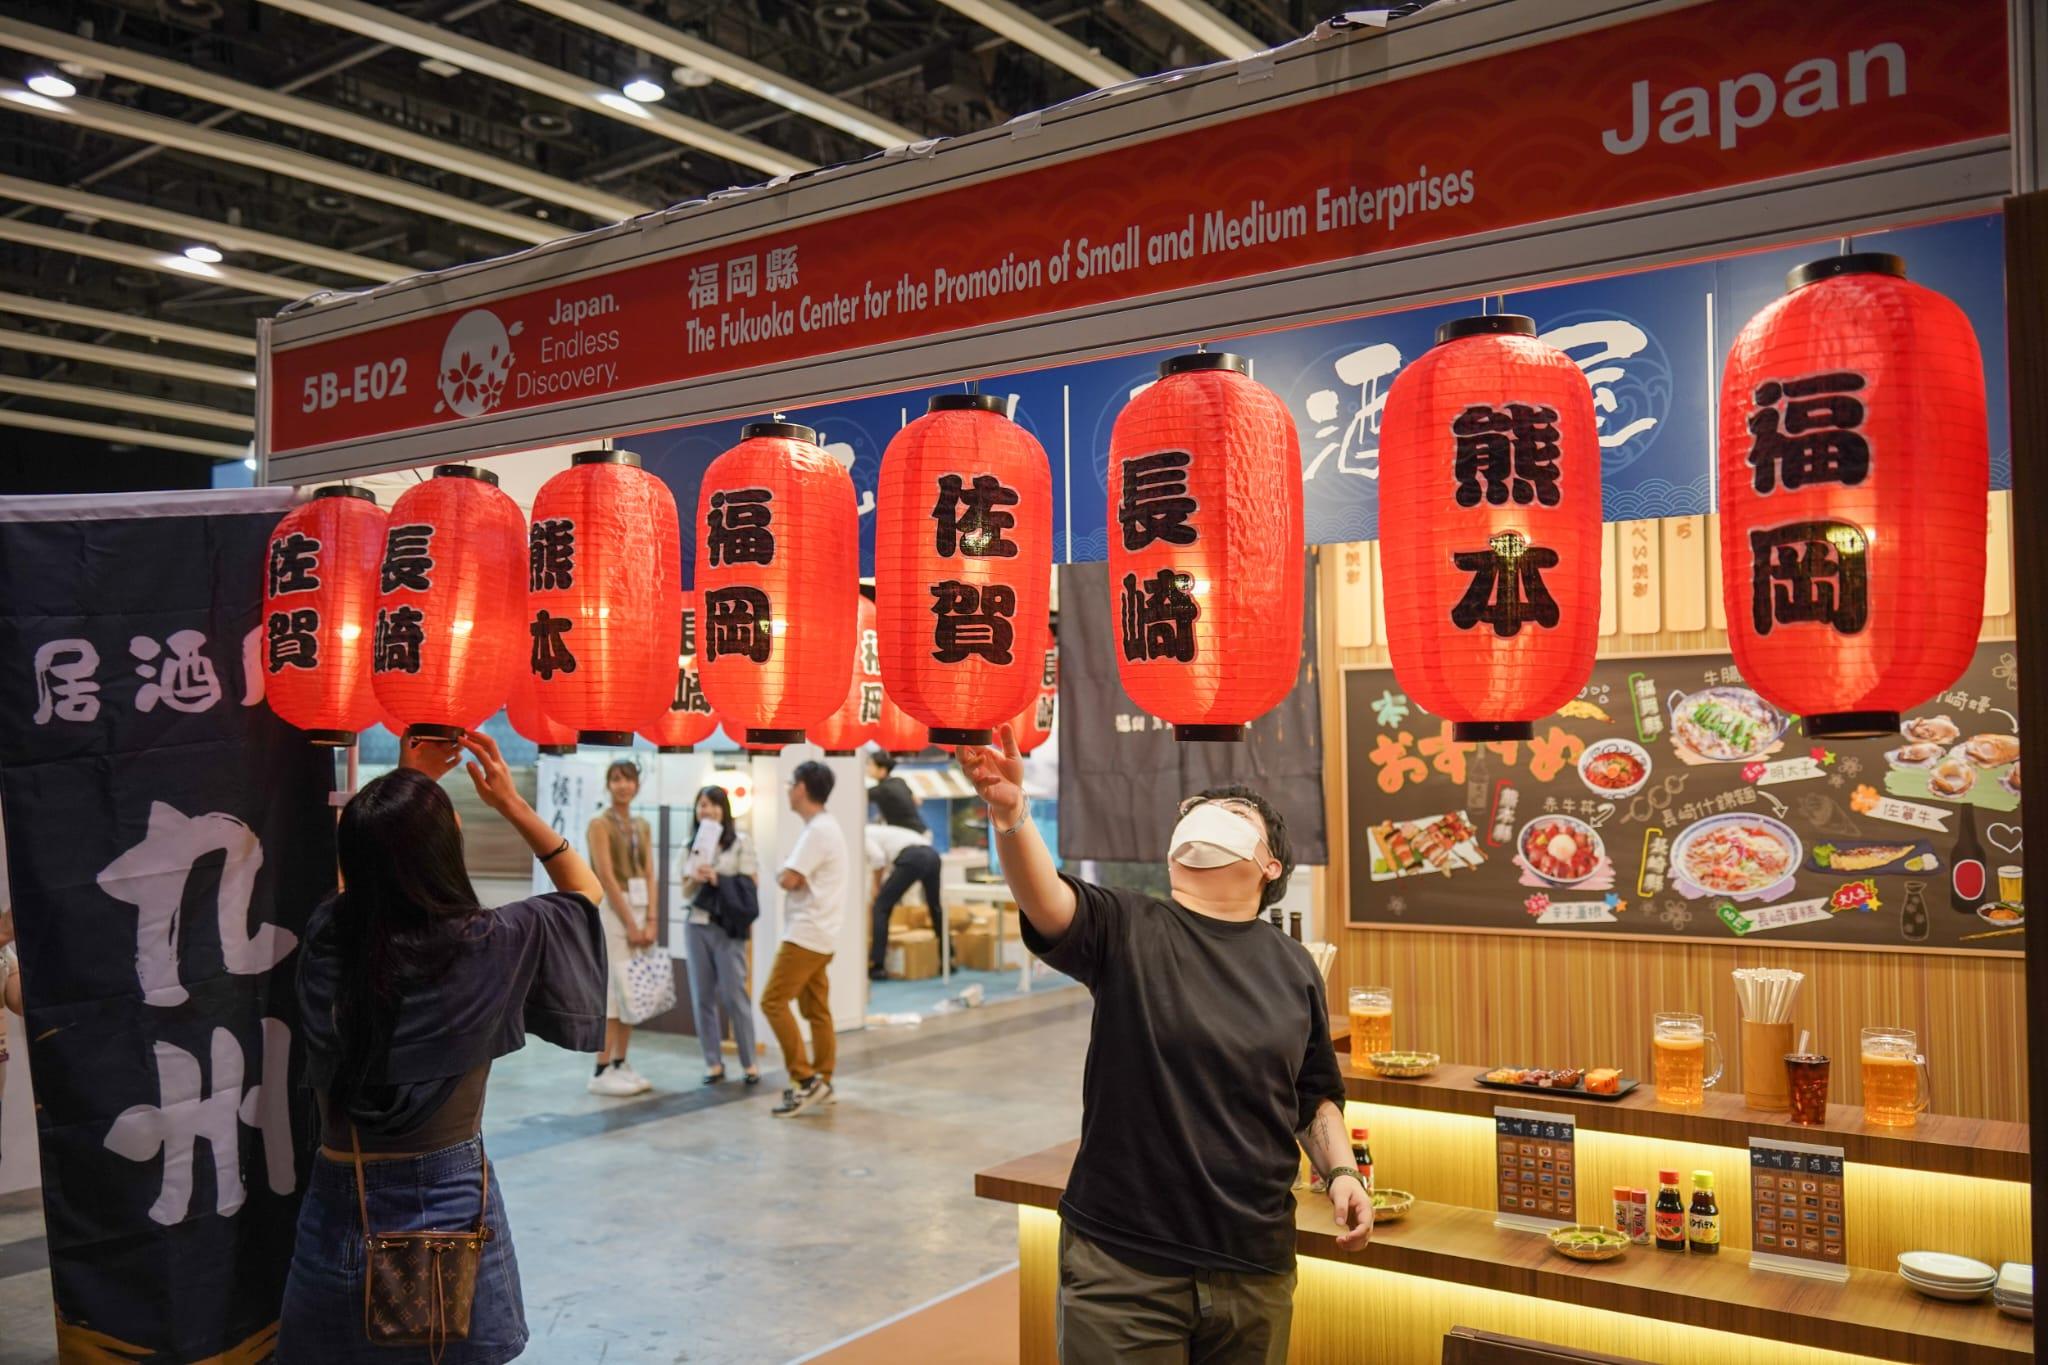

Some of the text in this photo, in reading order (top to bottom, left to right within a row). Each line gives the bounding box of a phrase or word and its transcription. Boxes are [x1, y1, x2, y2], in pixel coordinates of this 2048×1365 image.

[1602, 41, 1907, 155] Japan
[548, 294, 620, 328] Japan.
[686, 165, 1476, 354] The Fukuoka Center for the Promotion of Small and Medium Enterprises
[687, 244, 800, 311] 福岡縣
[302, 357, 408, 413] 5B-E02
[516, 360, 620, 399] Discovery.
[541, 327, 620, 362] Endless
[705, 488, 775, 665] 福岡
[929, 473, 1020, 665] 佐賀
[1117, 449, 1200, 663] 長崎
[1450, 402, 1562, 640] 熊本
[1748, 370, 1872, 636] 福岡
[268, 532, 322, 675] 佐賀
[373, 522, 437, 675] 長崎
[529, 517, 577, 681] 熊本
[97, 800, 298, 1226] 九州
